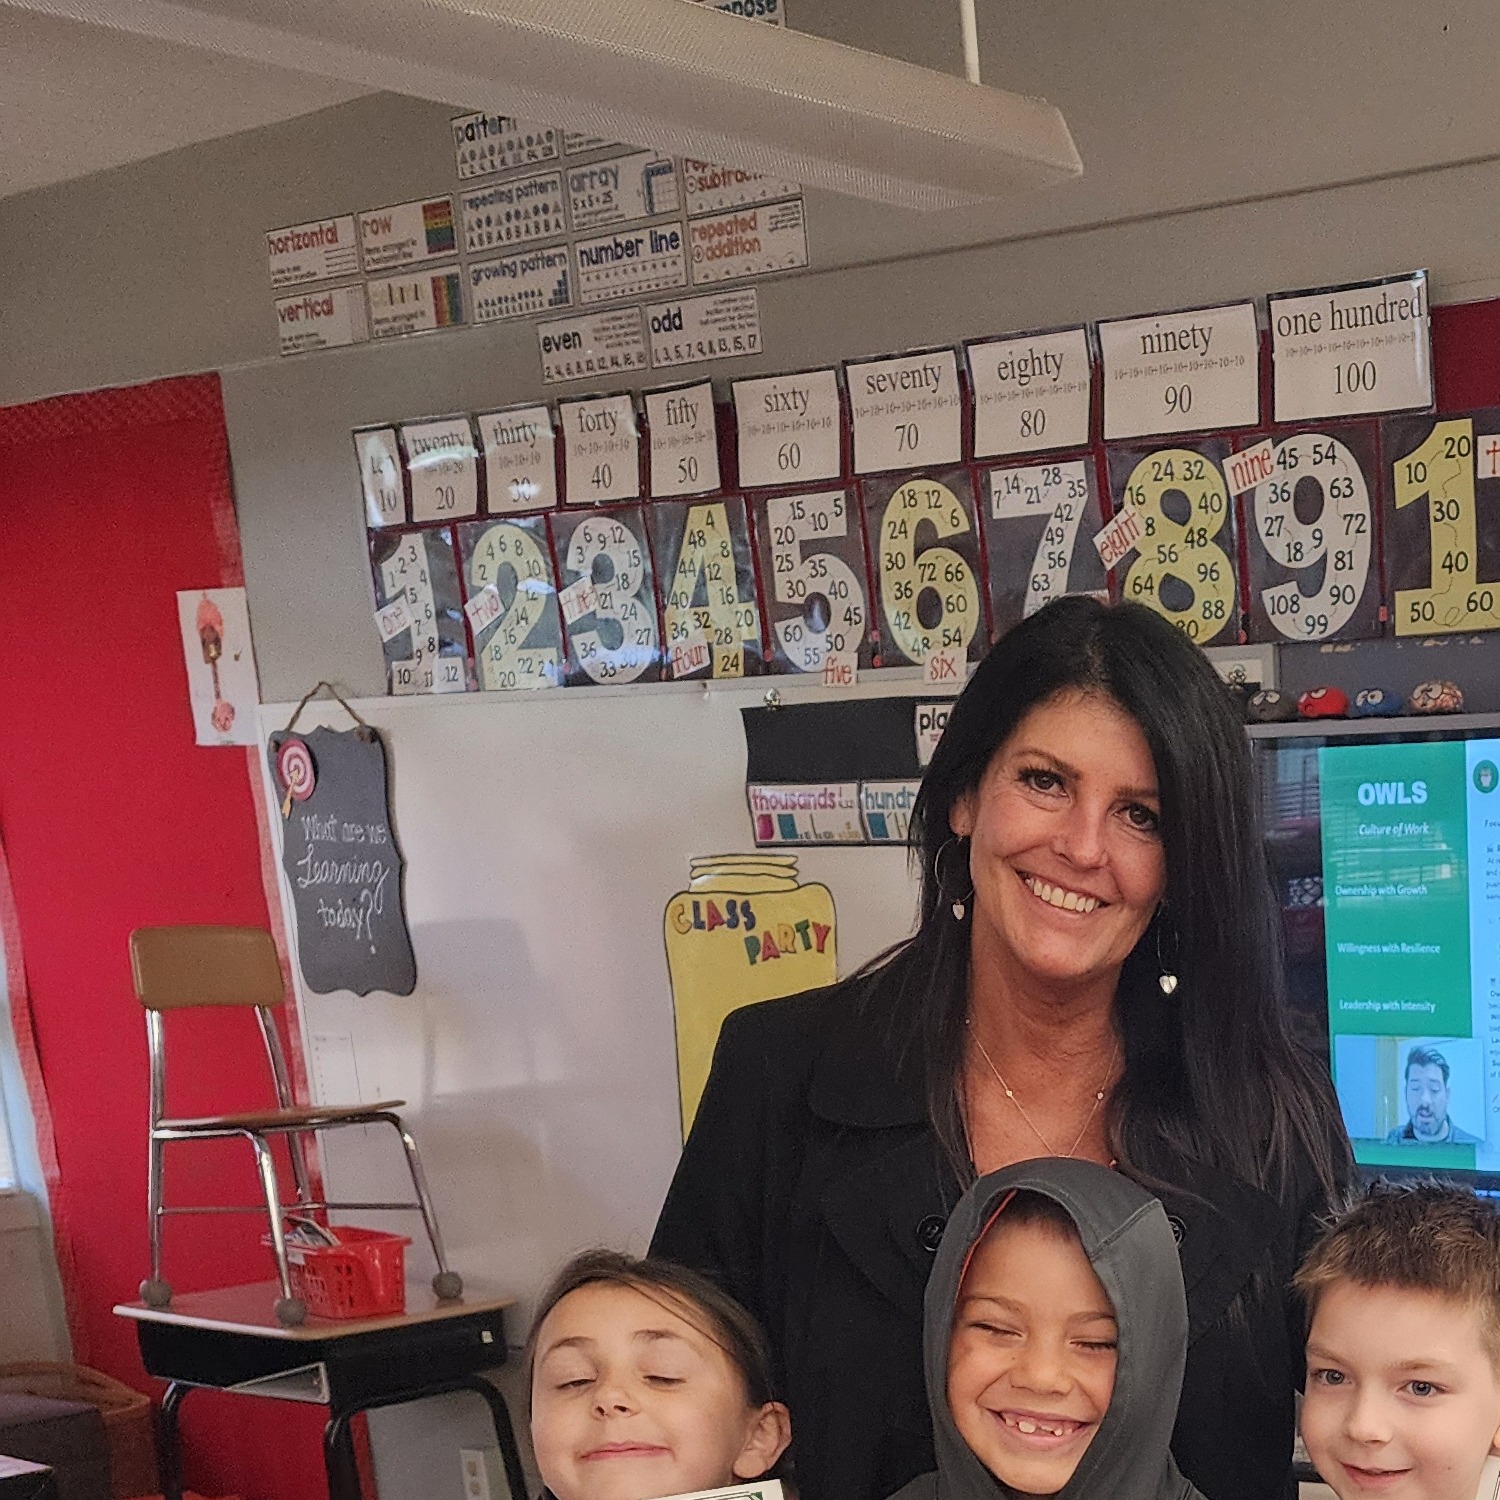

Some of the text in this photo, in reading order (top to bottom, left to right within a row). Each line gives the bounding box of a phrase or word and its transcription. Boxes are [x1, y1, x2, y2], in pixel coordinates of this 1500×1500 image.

[268, 222, 338, 255] horizontal
[362, 216, 393, 238] row
[691, 213, 758, 243] repeated
[579, 229, 680, 268] number line
[706, 236, 761, 261] addition
[279, 295, 334, 324] vertical
[651, 306, 683, 334] odd
[1277, 287, 1423, 339] one hundred
[542, 330, 582, 354] even
[1141, 323, 1213, 356] ninety
[866, 364, 943, 394] seventy
[997, 346, 1064, 387] eighty
[1335, 361, 1378, 395] 100
[666, 398, 699, 427] fifty
[764, 385, 810, 417] sixty
[1164, 384, 1192, 415] 90
[493, 419, 537, 447] thirty
[577, 407, 618, 435] forty
[1020, 408, 1046, 438] 80
[895, 423, 919, 452] 70
[678, 458, 698, 484] 50
[778, 443, 800, 470] 60
[1231, 450, 1275, 490] nine
[592, 464, 612, 488] 40
[436, 486, 455, 511] 20
[1100, 511, 1142, 567] eight
[670, 643, 706, 674] four
[822, 654, 852, 684] five
[930, 650, 956, 679] six
[752, 787, 836, 812] thousands
[1357, 781, 1429, 806] OWLS
[1359, 823, 1392, 836] Culture
[1404, 822, 1430, 835] Work
[297, 843, 391, 914] Learning
[672, 899, 757, 935] CLASS
[743, 918, 832, 966] PARTY
